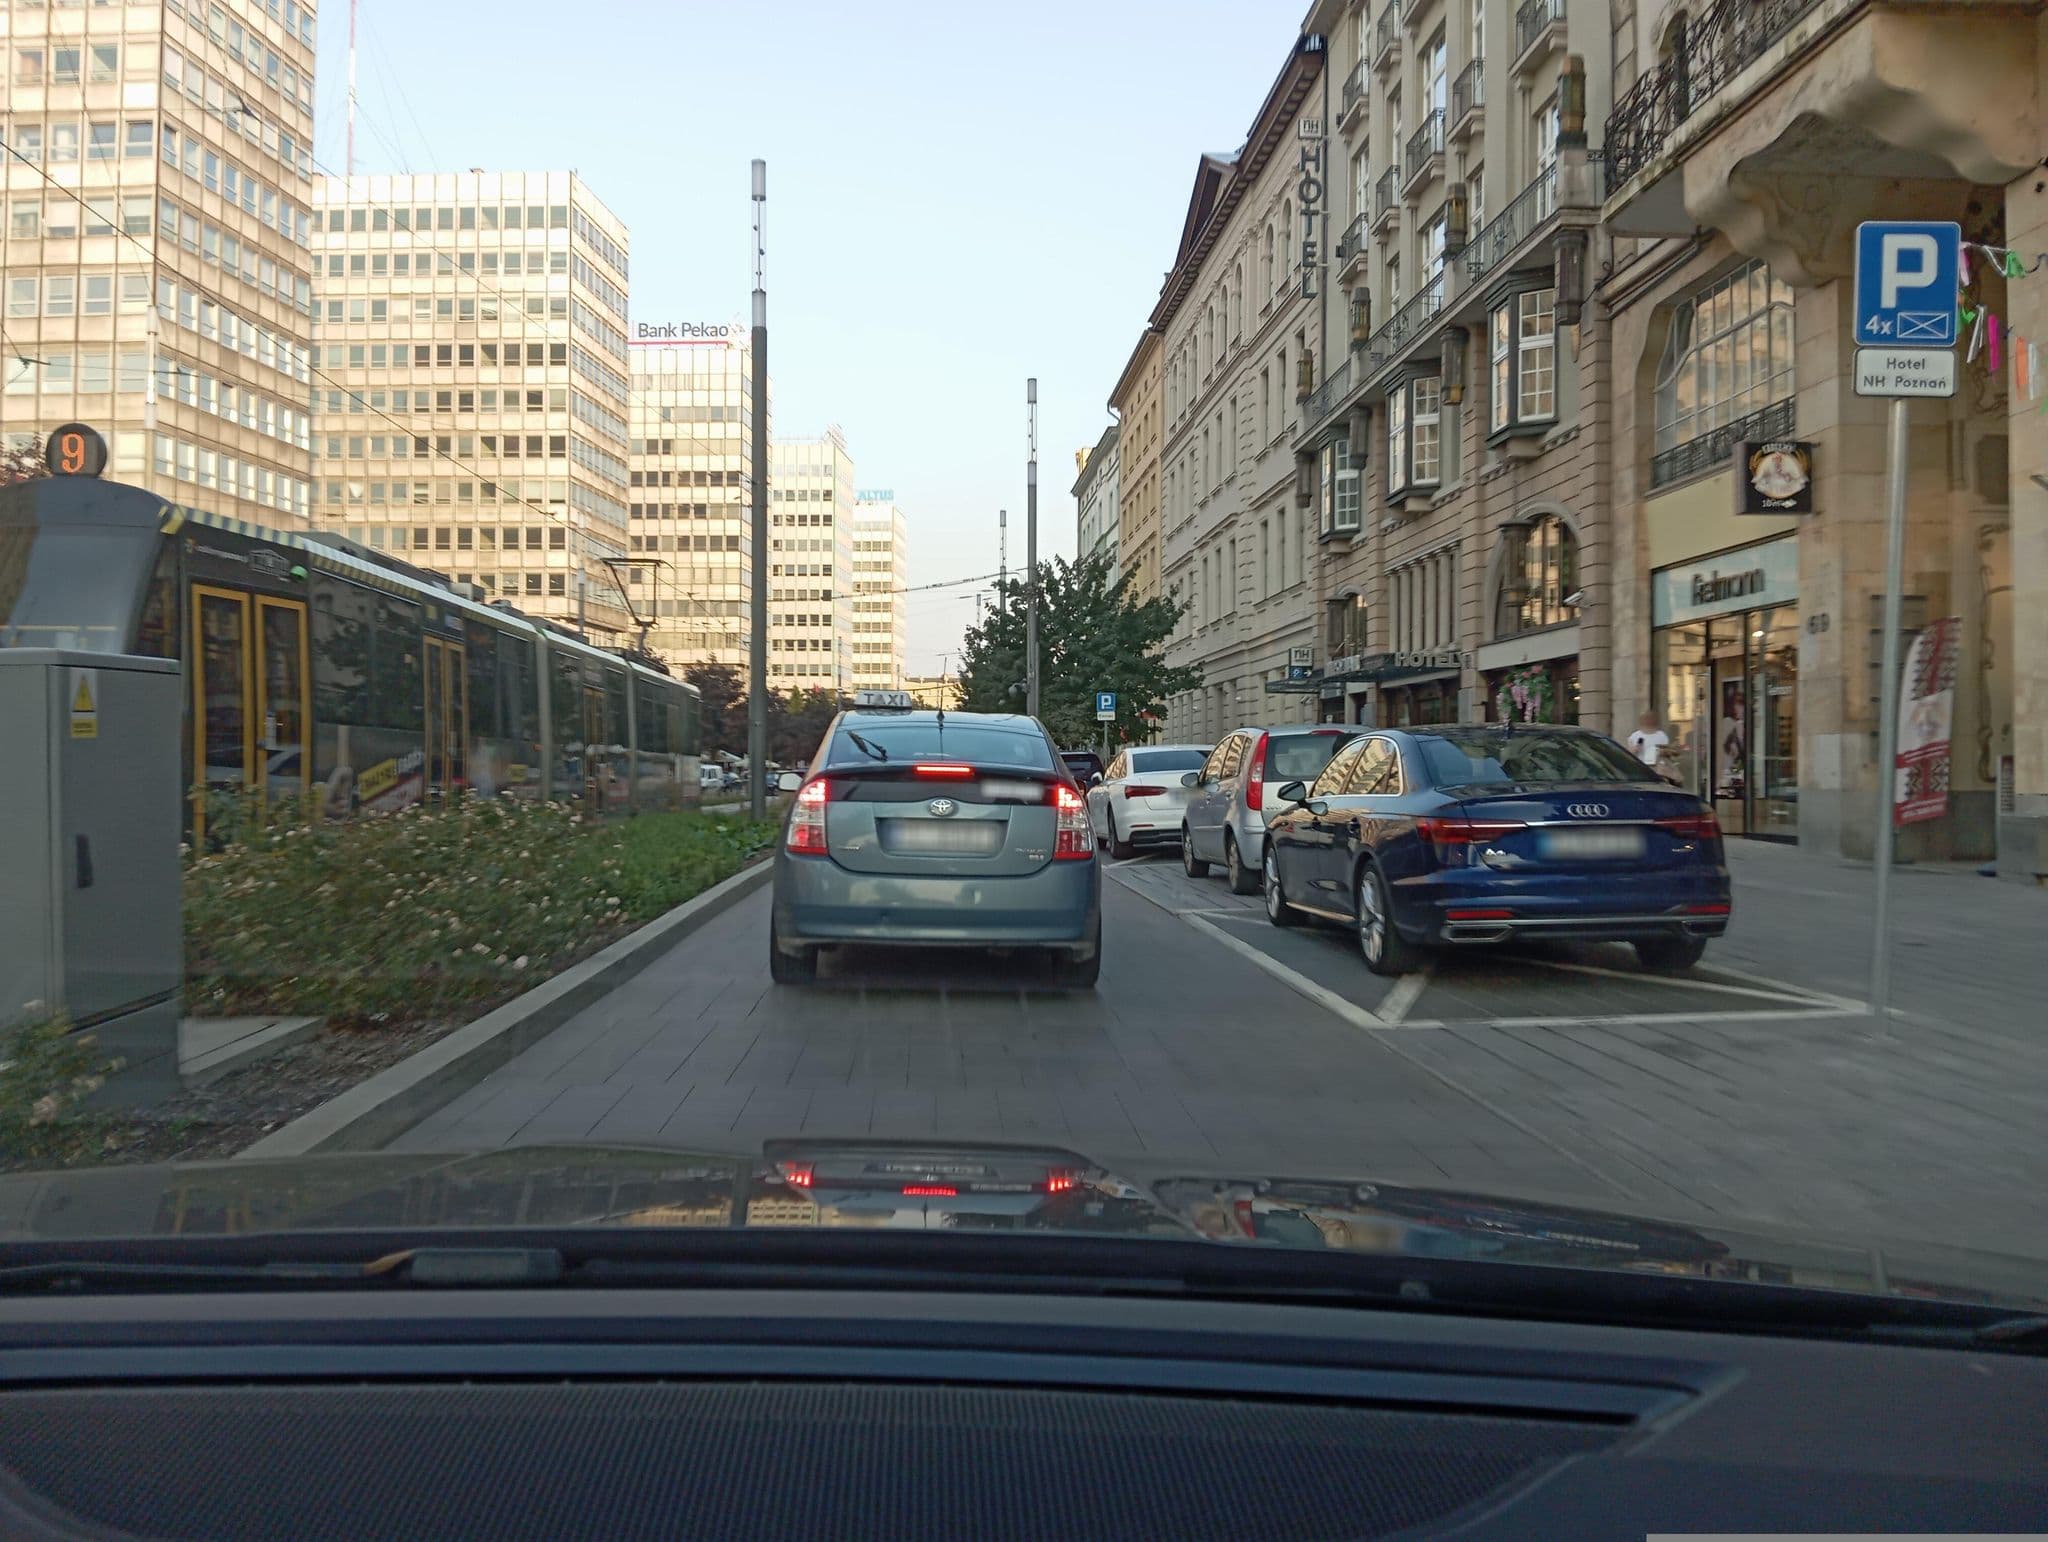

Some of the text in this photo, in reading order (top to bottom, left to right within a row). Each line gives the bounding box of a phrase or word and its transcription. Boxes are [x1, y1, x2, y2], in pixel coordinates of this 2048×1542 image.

[1299, 146, 1322, 299] HOTEL
[1880, 234, 1938, 308] P
[638, 322, 729, 338] Bank Pekao
[1865, 315, 1894, 335] 4x
[1886, 357, 1926, 370] Hotel
[1863, 374, 1946, 389] NH Poznań
[62, 433, 85, 473] 9
[858, 489, 894, 501] ALTUS
[1394, 652, 1461, 669] HOTEL
[863, 693, 904, 706] TAXI
[1101, 695, 1111, 709] P
